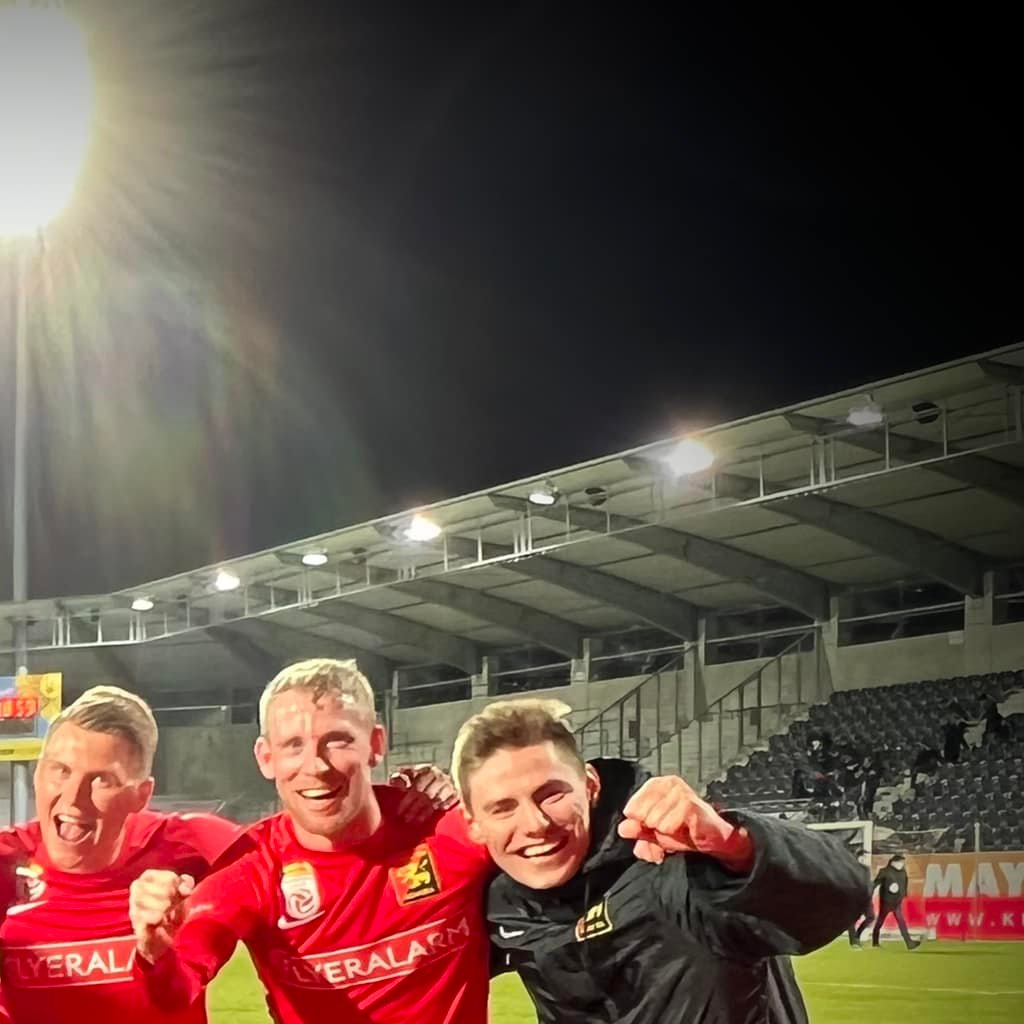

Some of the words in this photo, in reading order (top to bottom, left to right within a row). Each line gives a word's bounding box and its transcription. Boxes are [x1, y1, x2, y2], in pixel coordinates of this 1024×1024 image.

[922, 863, 1024, 898] MAY
[925, 911, 1024, 928] WWW.K
[283, 916, 471, 984] LYERALARM
